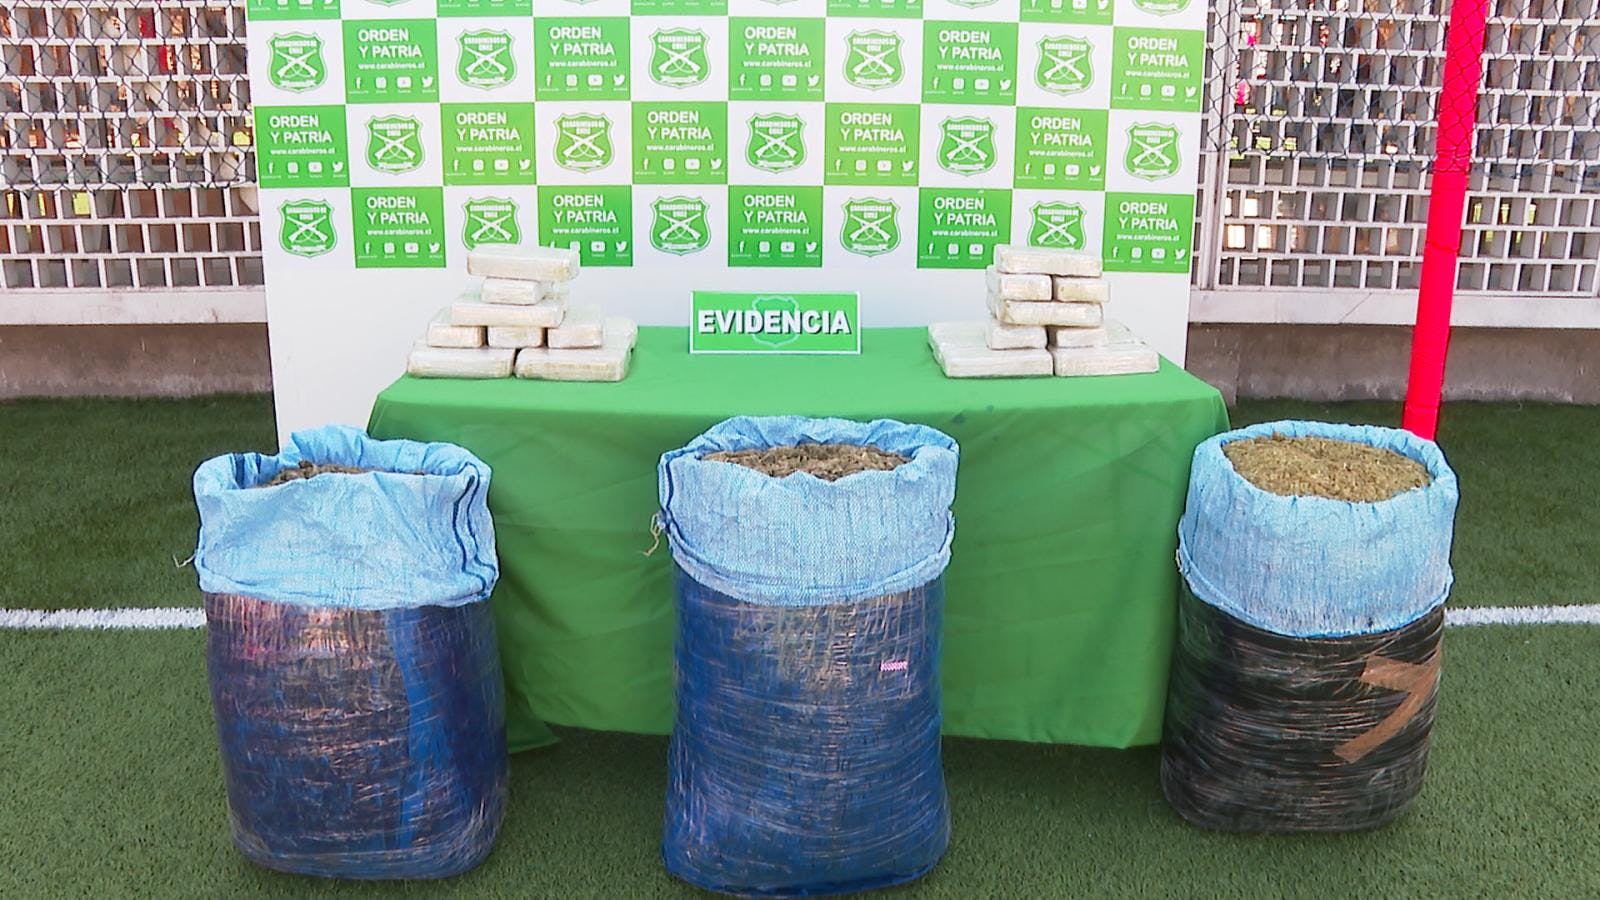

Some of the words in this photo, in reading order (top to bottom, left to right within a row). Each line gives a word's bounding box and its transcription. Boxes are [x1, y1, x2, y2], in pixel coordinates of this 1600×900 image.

[359, 29, 408, 42] ORDEN
[550, 26, 601, 39] ORDEN
[745, 26, 796, 39] ORDEN
[940, 30, 990, 43] ORDEN
[550, 43, 559, 55] Y
[564, 42, 614, 55] PATRIA
[745, 43, 754, 54] Y
[758, 43, 808, 55] PATRIA
[1128, 36, 1177, 50] ORDEN
[359, 46, 368, 58] Y
[372, 45, 422, 58] PATRIA
[940, 46, 948, 58] Y
[952, 46, 1001, 60] PATRIA
[1128, 52, 1136, 64] Y
[1140, 53, 1188, 66] PATRIA
[270, 115, 318, 128] ORDEN
[456, 112, 506, 124] ORDEN
[648, 111, 698, 124] ORDEN
[841, 112, 891, 125] ORDEN
[1032, 116, 1080, 130] ORDEN
[271, 132, 279, 144] Y
[284, 131, 332, 143] PATRIA
[457, 128, 466, 140] Y
[470, 128, 520, 140] PATRIA
[648, 127, 657, 139] Y
[662, 127, 711, 139] PATRIA
[841, 128, 850, 140] Y
[854, 128, 904, 141] PATRIA
[1031, 132, 1040, 144] Y
[1044, 133, 1092, 146] PATRIA
[367, 196, 415, 208] ORDEN
[554, 195, 603, 207] ORDEN
[745, 195, 794, 208] ORDEN
[934, 197, 984, 210] ORDEN
[1120, 202, 1167, 214] ORDEN
[368, 212, 376, 224] Y
[381, 212, 429, 224] PATRIA
[554, 210, 562, 223] Y
[567, 210, 616, 222] PATRIA
[744, 210, 753, 223] Y
[758, 210, 807, 223] PATRIA
[934, 212, 943, 224] Y
[947, 213, 996, 226] PATRIA
[1119, 217, 1128, 229] Y
[1132, 218, 1178, 230] PATRIA
[698, 310, 851, 334] EVIDENCIA
